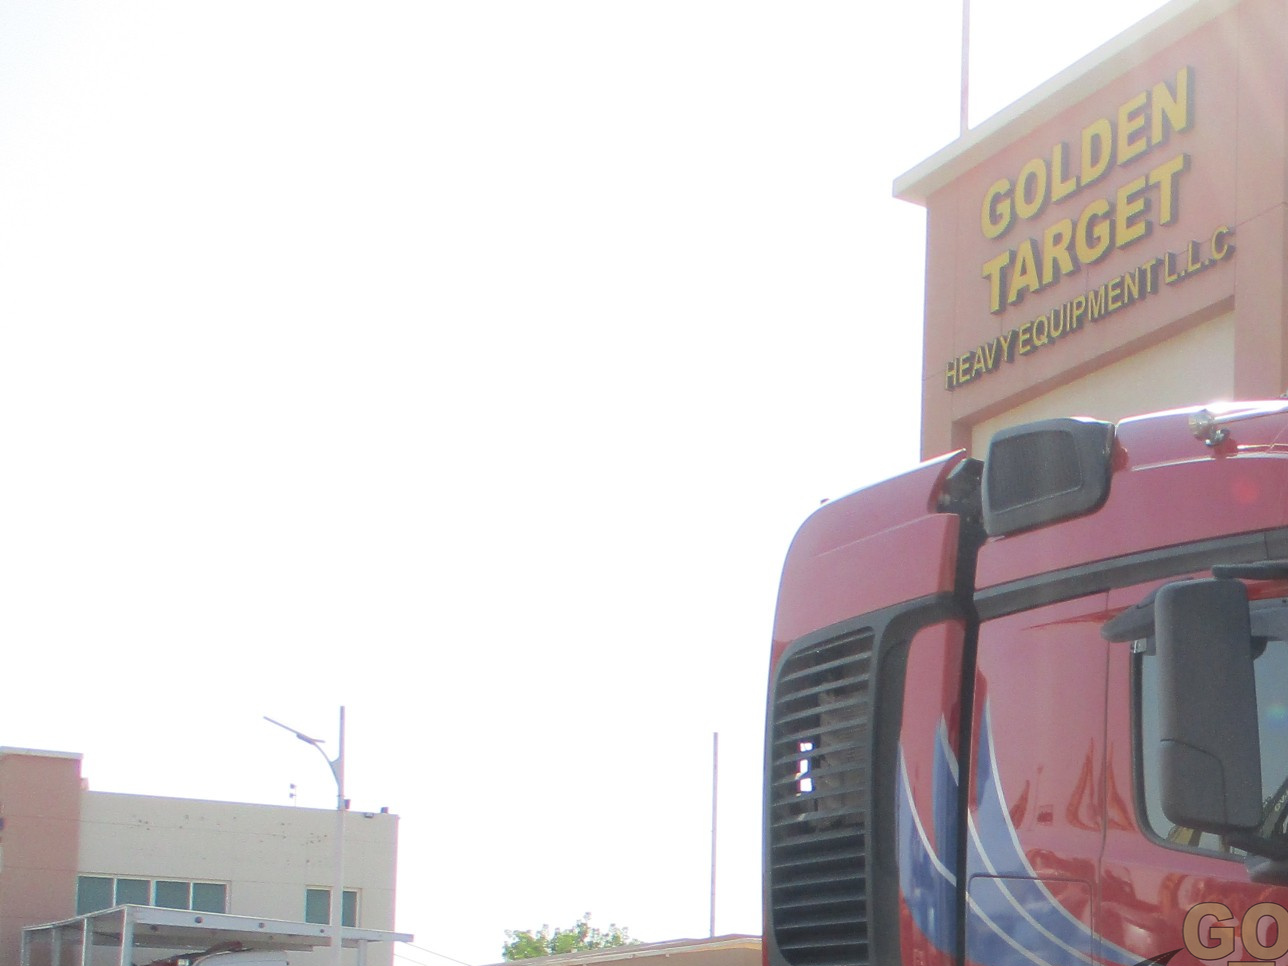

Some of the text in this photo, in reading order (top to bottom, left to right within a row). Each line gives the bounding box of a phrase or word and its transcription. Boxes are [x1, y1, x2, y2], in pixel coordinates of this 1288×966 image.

[981, 66, 1193, 242] GOLDEN
[982, 154, 1191, 314] TARGET
[944, 226, 1235, 391] HEAVY EQUIPMENT L.L.C
